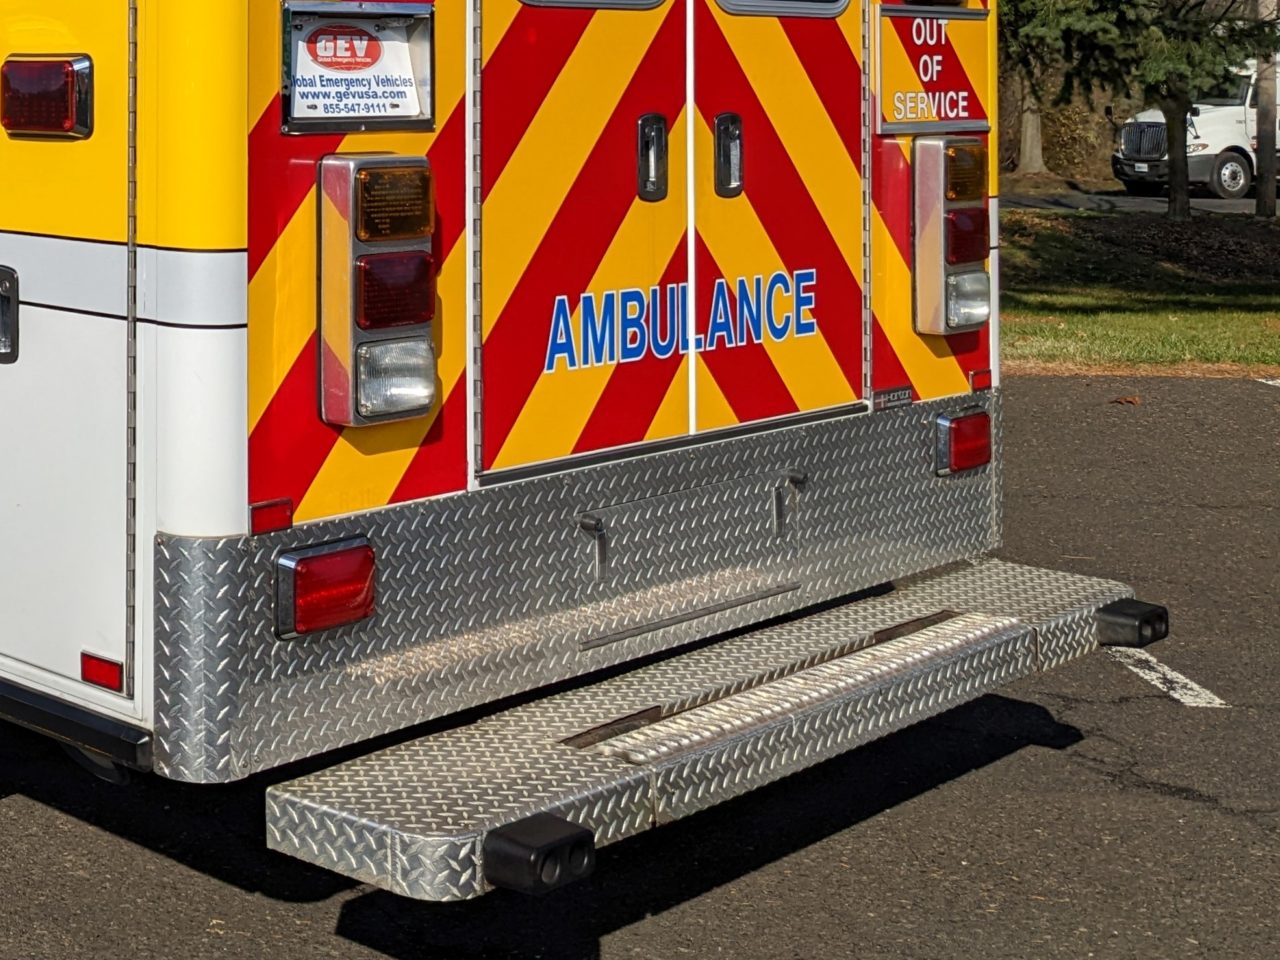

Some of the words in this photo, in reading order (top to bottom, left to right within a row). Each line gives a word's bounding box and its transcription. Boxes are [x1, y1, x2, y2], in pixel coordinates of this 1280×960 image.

[912, 18, 949, 46] OUT
[316, 35, 369, 57] GEV
[919, 55, 943, 82] OF
[291, 74, 317, 88] lobal
[319, 74, 371, 91] Emergency
[373, 74, 414, 88] Vehicles
[298, 89, 408, 103] www.gevusa.com
[323, 102, 387, 114] 855-547-9111
[893, 91, 969, 120] SERVICE
[544, 268, 817, 374] AMBULANCE
